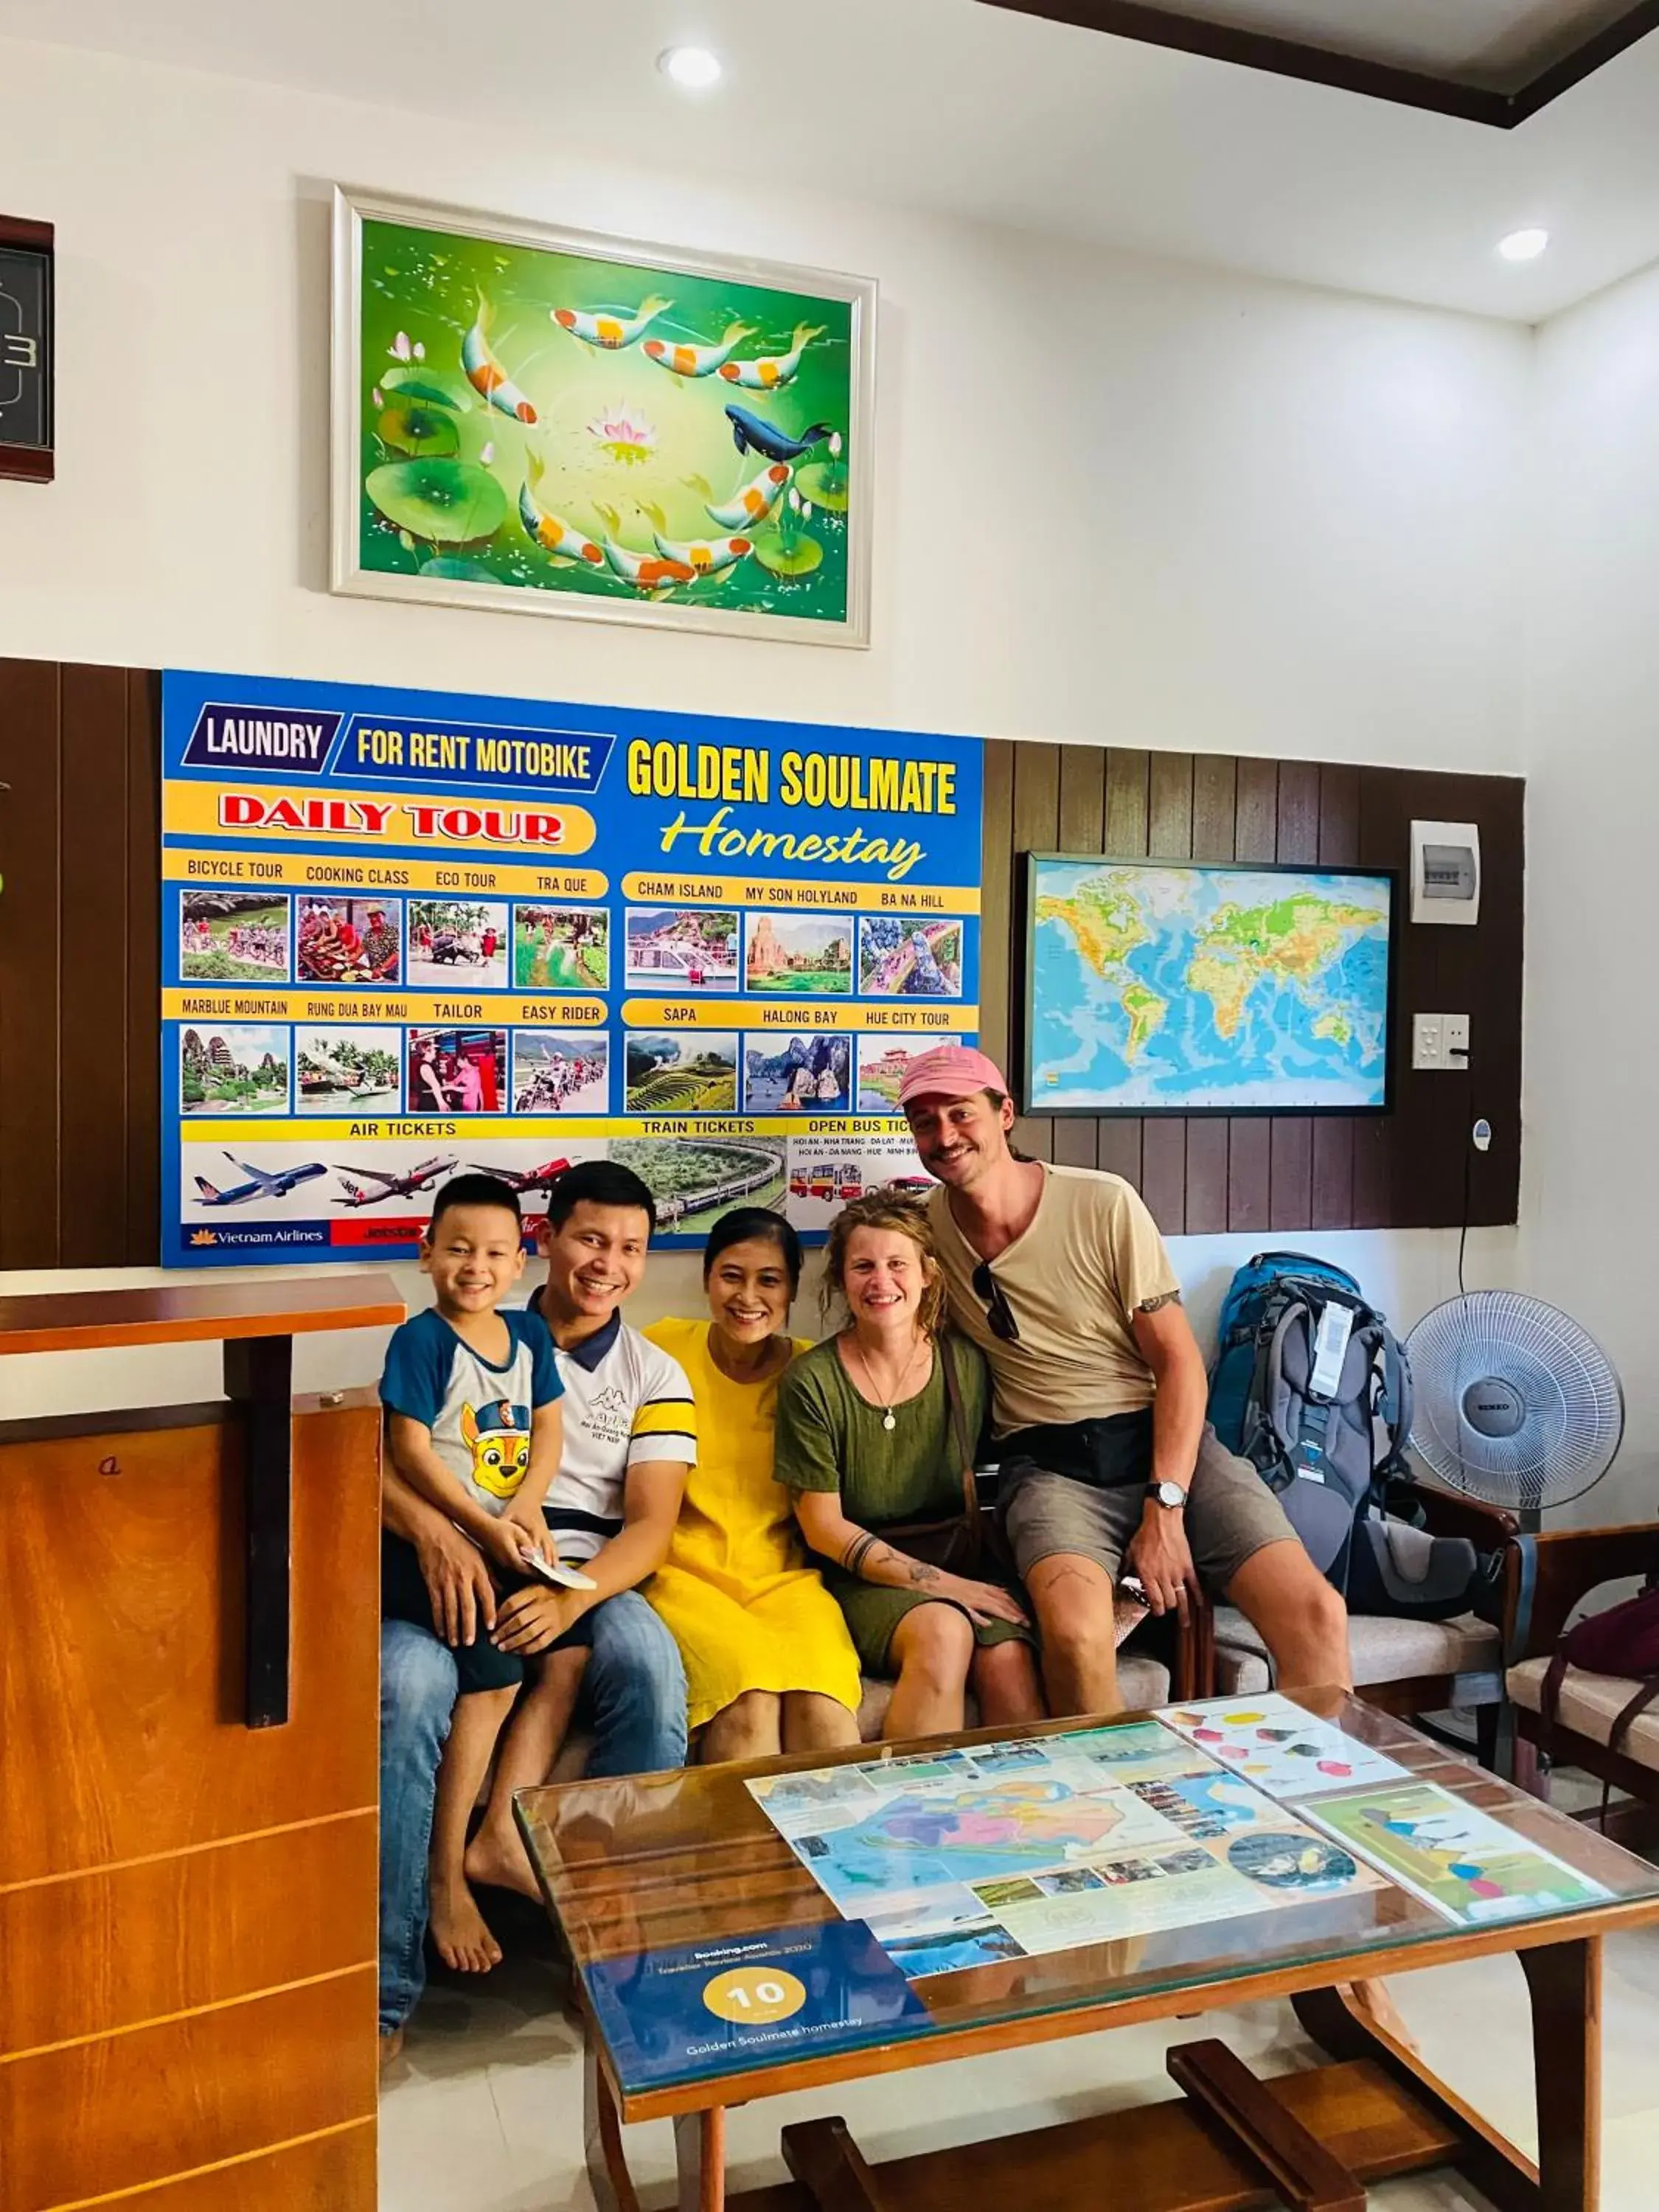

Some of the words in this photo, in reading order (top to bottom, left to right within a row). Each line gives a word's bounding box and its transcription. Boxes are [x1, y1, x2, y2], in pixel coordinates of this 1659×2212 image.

[207, 717, 322, 759] LAUNDRY
[358, 729, 403, 765] FOR
[410, 733, 470, 771] RENT
[476, 739, 591, 779] MOTOBIKE
[626, 738, 769, 804] GOLDEN
[779, 751, 956, 815] SOULMATE
[218, 793, 396, 835] DAILY
[402, 804, 564, 846] TOUR
[660, 806, 926, 880] Homestay
[188, 860, 243, 877] BICYCLE
[248, 863, 282, 878] TOUR
[306, 866, 364, 883] COOKING
[368, 869, 408, 885] CLASS
[436, 872, 460, 886] ECO
[465, 873, 495, 888] TOUR
[538, 877, 561, 891] TRA
[564, 877, 587, 893] QUE
[638, 881, 675, 897] CHAM
[679, 883, 723, 898] ISLAND
[745, 887, 764, 901] MY
[769, 888, 793, 902] SON
[797, 889, 858, 904] HOLYLAND
[881, 893, 896, 905] BA
[900, 894, 917, 906] NA
[921, 895, 944, 908] HILL
[182, 999, 231, 1015] MARBLUE
[234, 1000, 288, 1016] MOUNTAIN
[307, 1002, 335, 1017] RUNG
[338, 1003, 358, 1017] DUA
[362, 1004, 381, 1018] BAY
[386, 1004, 407, 1018] MAU
[434, 1004, 482, 1018] TAILOR
[522, 1006, 557, 1020] EASY
[562, 1006, 600, 1020] RIDER
[664, 1009, 696, 1021] SAPA
[763, 1009, 810, 1023] HALONG
[815, 1011, 838, 1024] BAY
[866, 1012, 888, 1025] HUE
[892, 1012, 917, 1026] CITY
[921, 1013, 949, 1026] TOUR
[350, 1123, 378, 1136] AIR
[387, 1122, 456, 1136] TICKETS
[642, 1121, 688, 1133] TRAIN
[695, 1121, 754, 1133] TICKETS
[809, 1121, 846, 1132] OPEN
[853, 1121, 880, 1132] BUS
[888, 1121, 912, 1132] TIC
[218, 1231, 272, 1244] Vietnam
[274, 1228, 323, 1243] Airlines
[727, 1982, 785, 2008] 10
[686, 2040, 736, 2056] Golden
[738, 2029, 799, 2046] Soulmate
[801, 2017, 862, 2034] homestay
